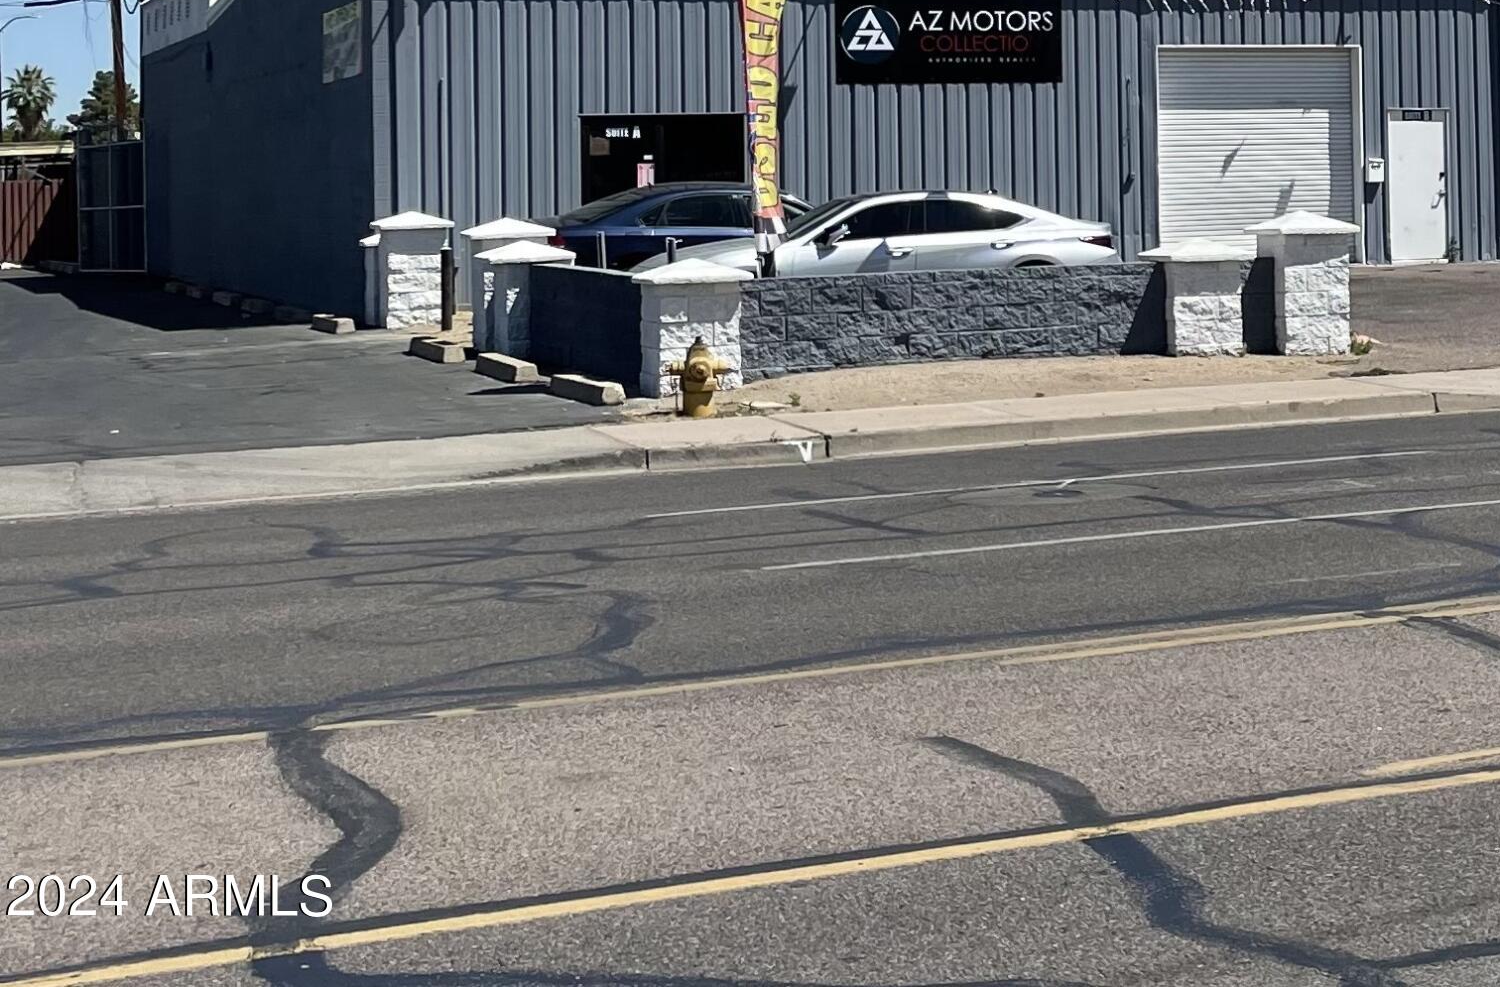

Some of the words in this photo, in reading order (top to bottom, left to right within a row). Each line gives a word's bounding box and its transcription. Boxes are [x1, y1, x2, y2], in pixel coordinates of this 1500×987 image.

[908, 11, 943, 31] AZ
[950, 10, 1054, 31] MOTORS
[920, 35, 1031, 52] COLLECTIO
[632, 125, 641, 138] A
